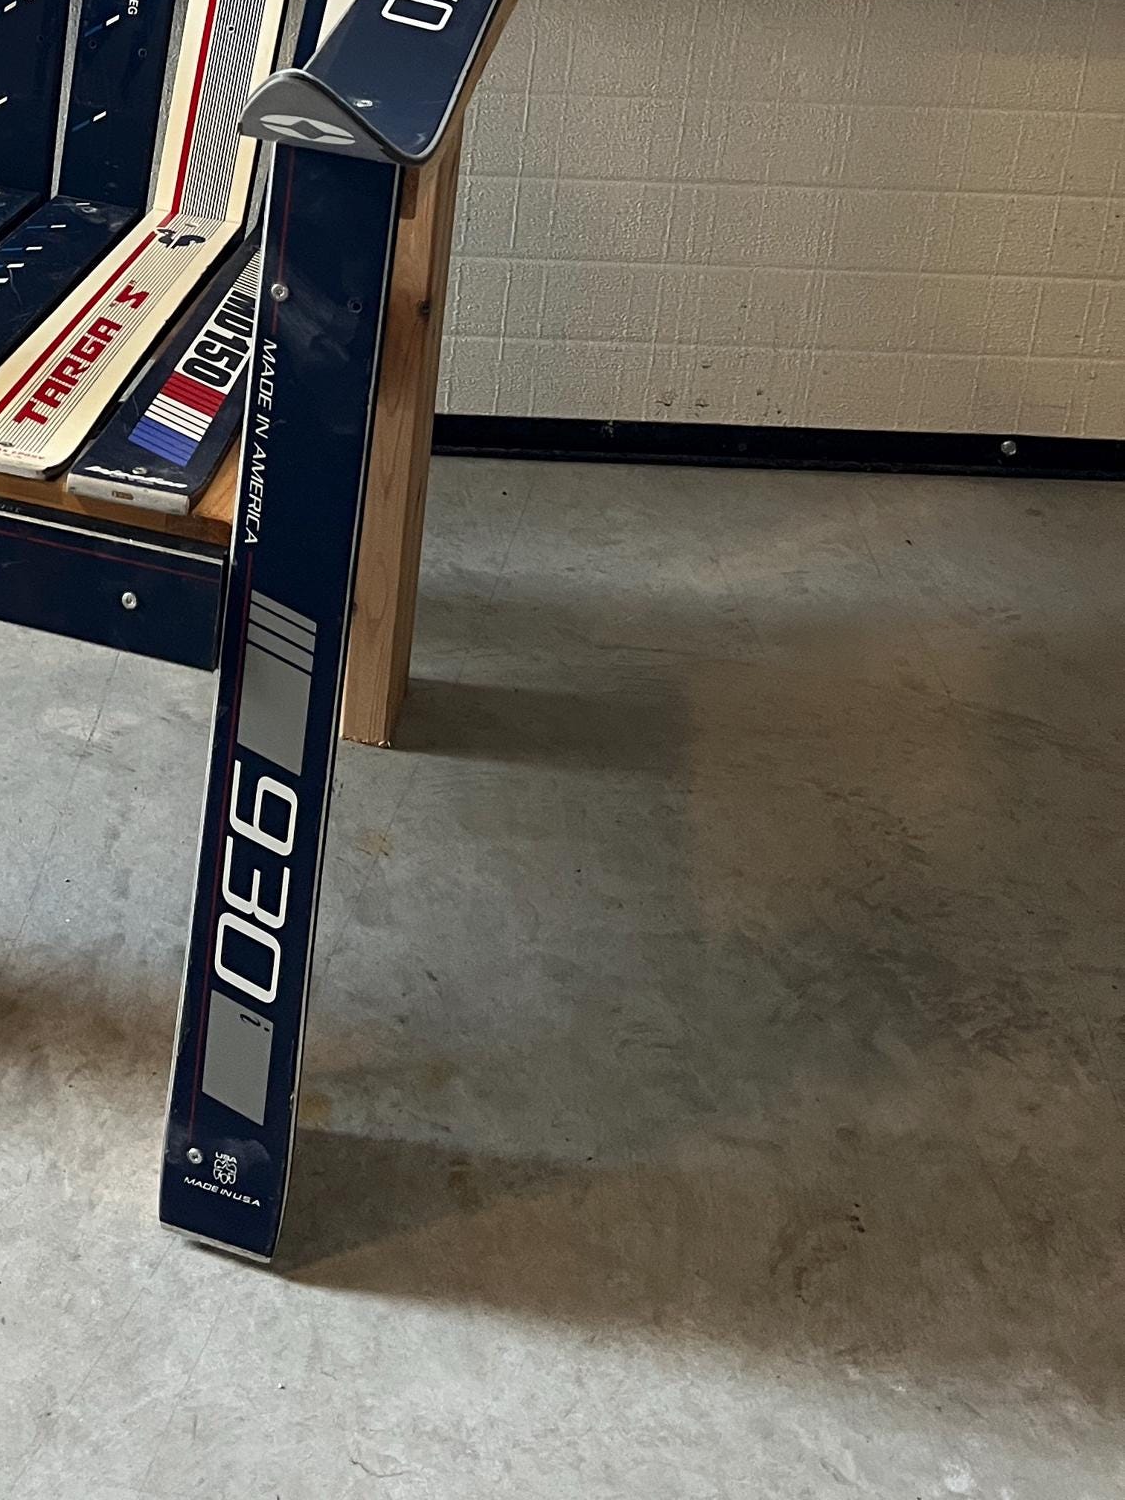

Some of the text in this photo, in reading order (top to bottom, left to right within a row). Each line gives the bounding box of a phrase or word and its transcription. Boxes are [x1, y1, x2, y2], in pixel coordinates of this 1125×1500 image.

[13, 316, 122, 424] TARGA
[244, 338, 278, 544] MADE IN AMERICA
[213, 758, 298, 1005] 930
[184, 1177, 261, 1207] MADE IN USA
